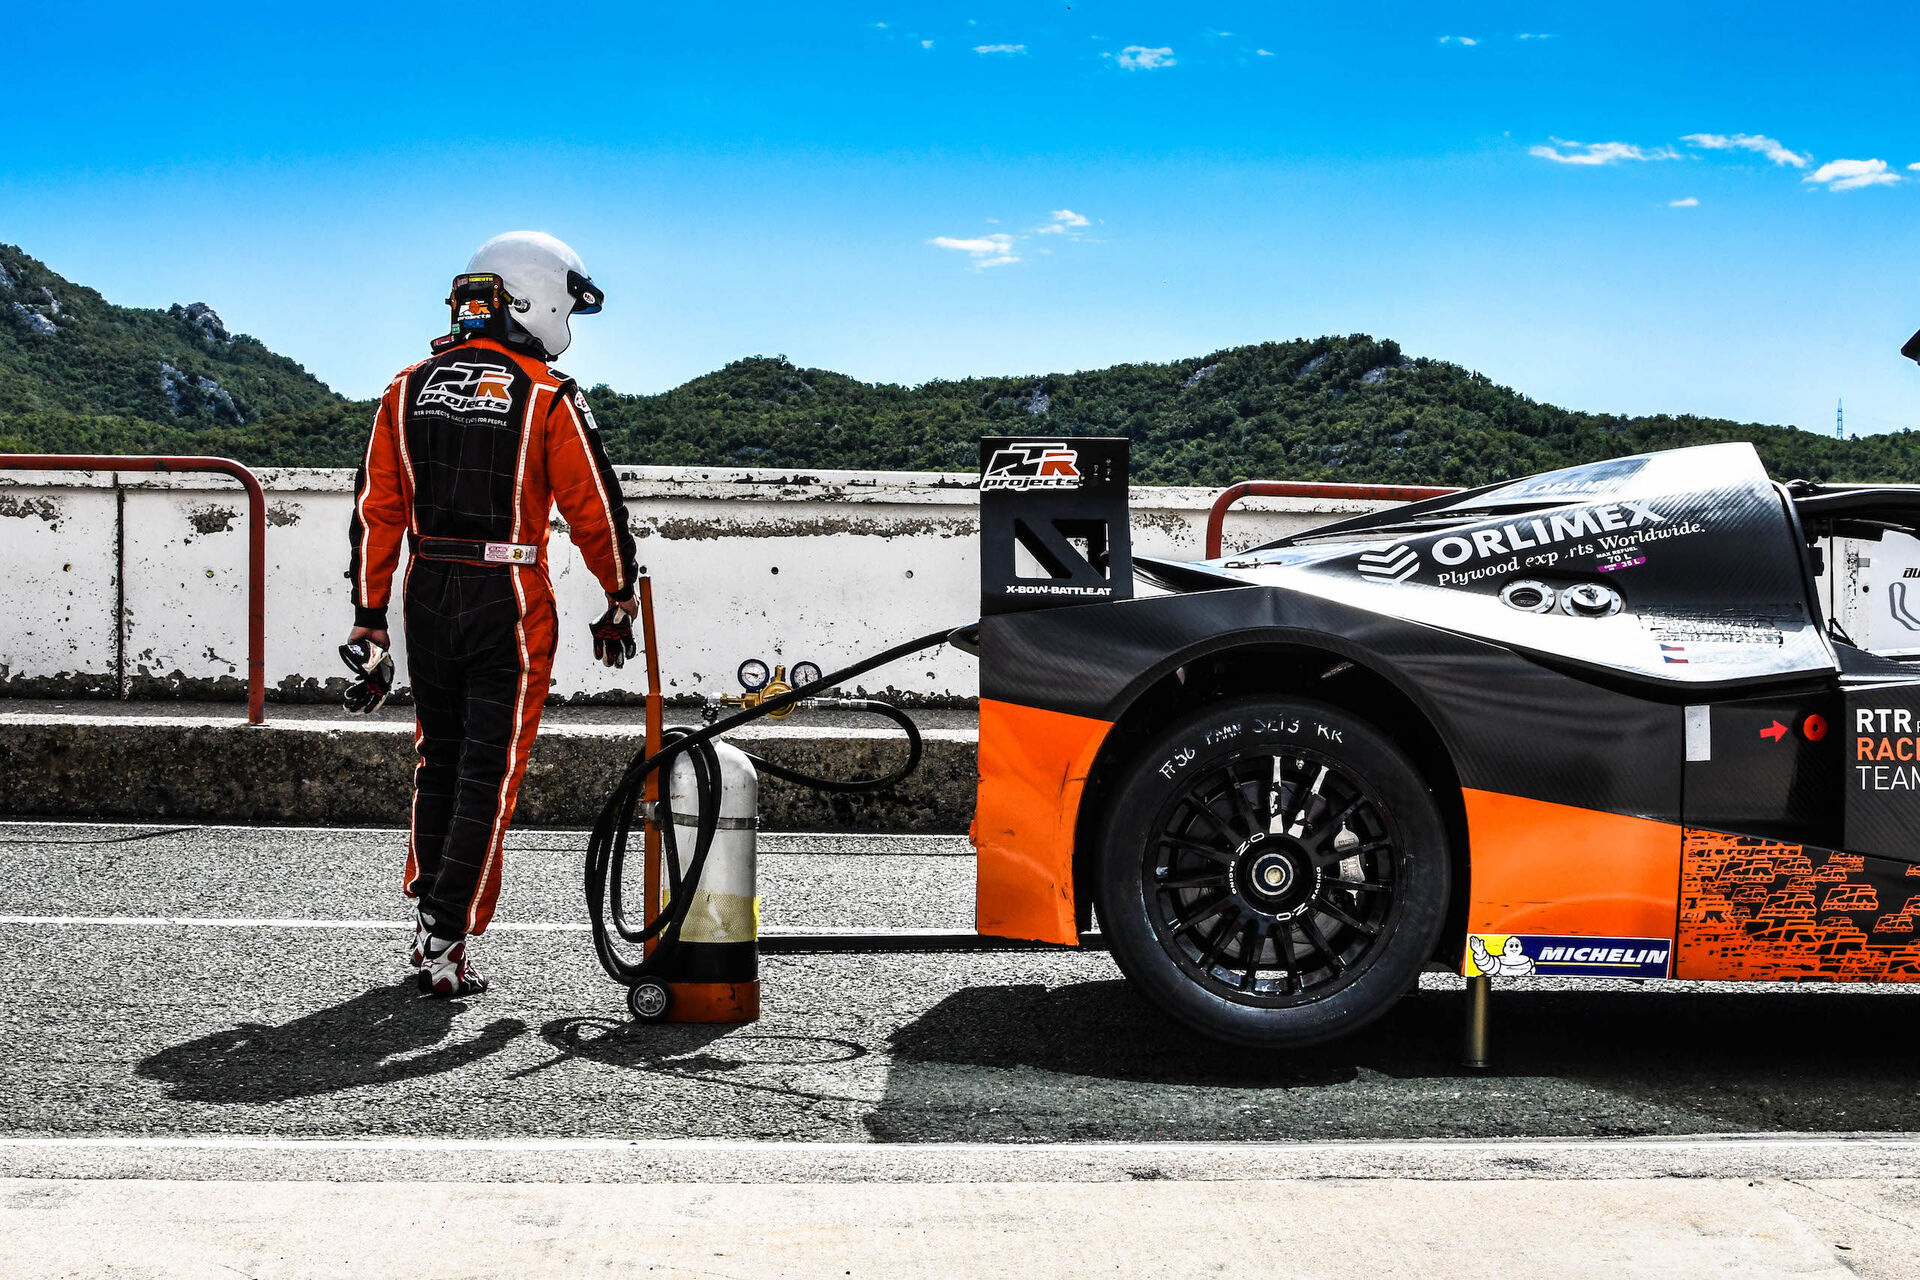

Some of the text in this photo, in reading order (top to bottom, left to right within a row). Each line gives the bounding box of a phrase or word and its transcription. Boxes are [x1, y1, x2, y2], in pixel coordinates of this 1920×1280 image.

[417, 393, 511, 411] projects
[981, 477, 1081, 490] projects
[1431, 501, 1665, 565] ORLIMEX
[1438, 522, 1706, 586] Plywood exprts Worldwide.
[1608, 554, 1621, 563] 70
[1612, 546, 1638, 555] REFUEL
[1621, 560, 1632, 568] 35
[1006, 585, 1112, 596] X-BOW-BATTLE.AT
[1856, 709, 1912, 733] RTR
[1857, 737, 1920, 761] RAC
[1538, 946, 1668, 964] MICHELIN
